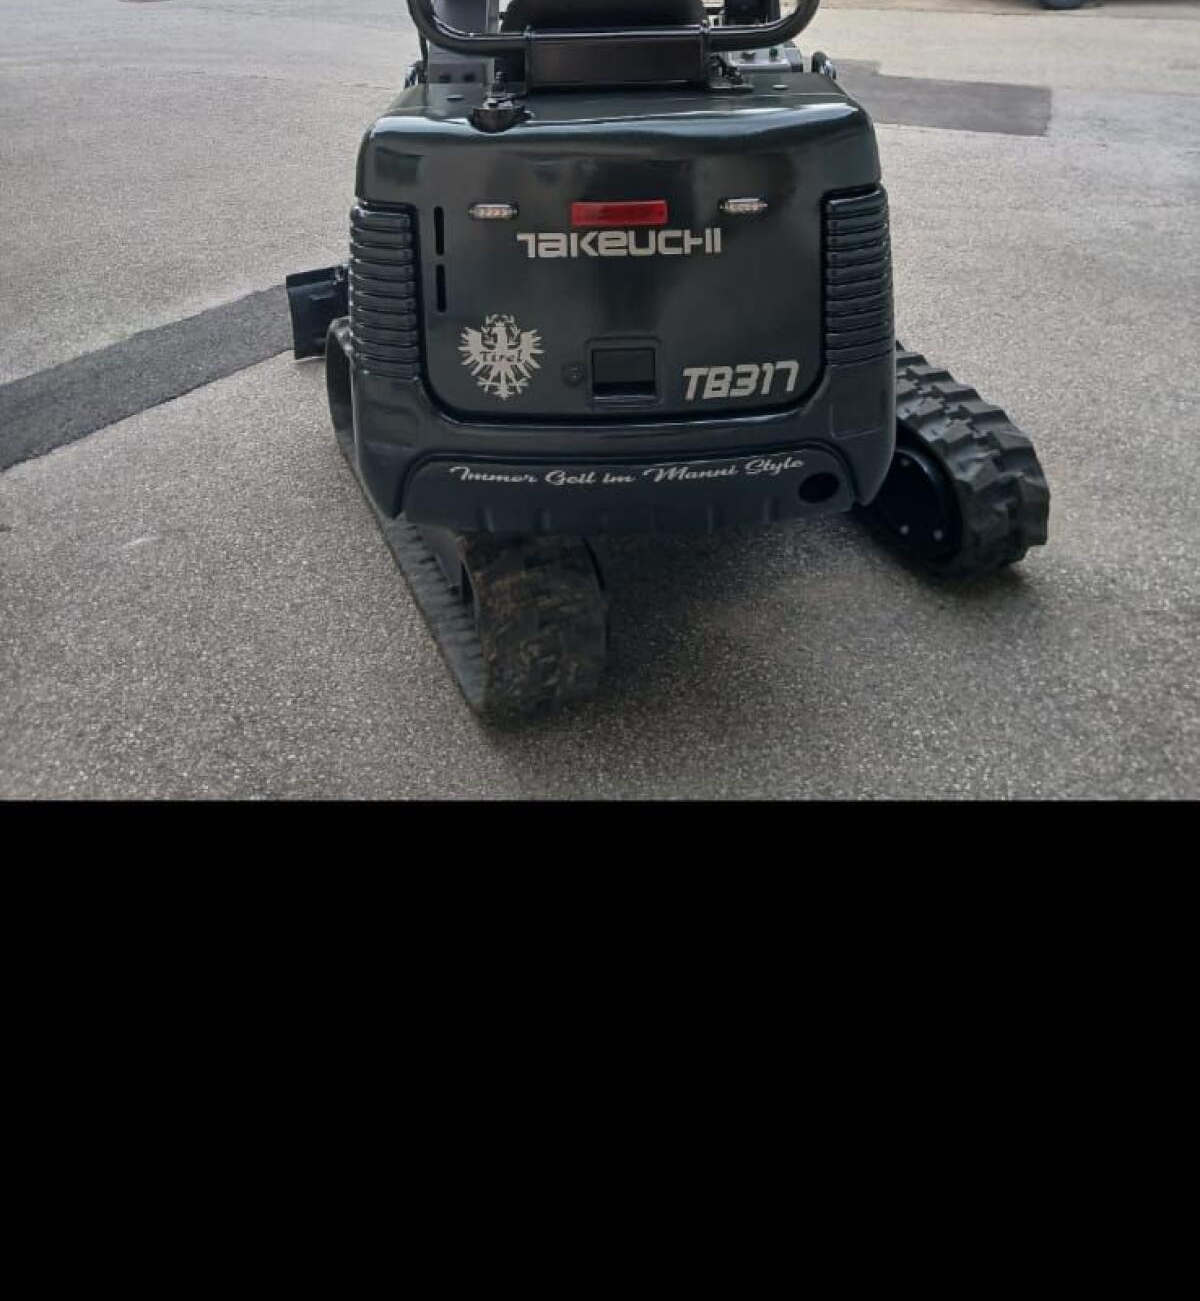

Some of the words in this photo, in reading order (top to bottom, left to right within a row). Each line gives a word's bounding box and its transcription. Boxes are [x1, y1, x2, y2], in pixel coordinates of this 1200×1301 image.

[682, 360, 800, 400] TB317
[450, 466, 538, 484] Immer
[602, 472, 635, 484] im
[642, 465, 739, 483] Manni
[744, 456, 805, 475] Style
